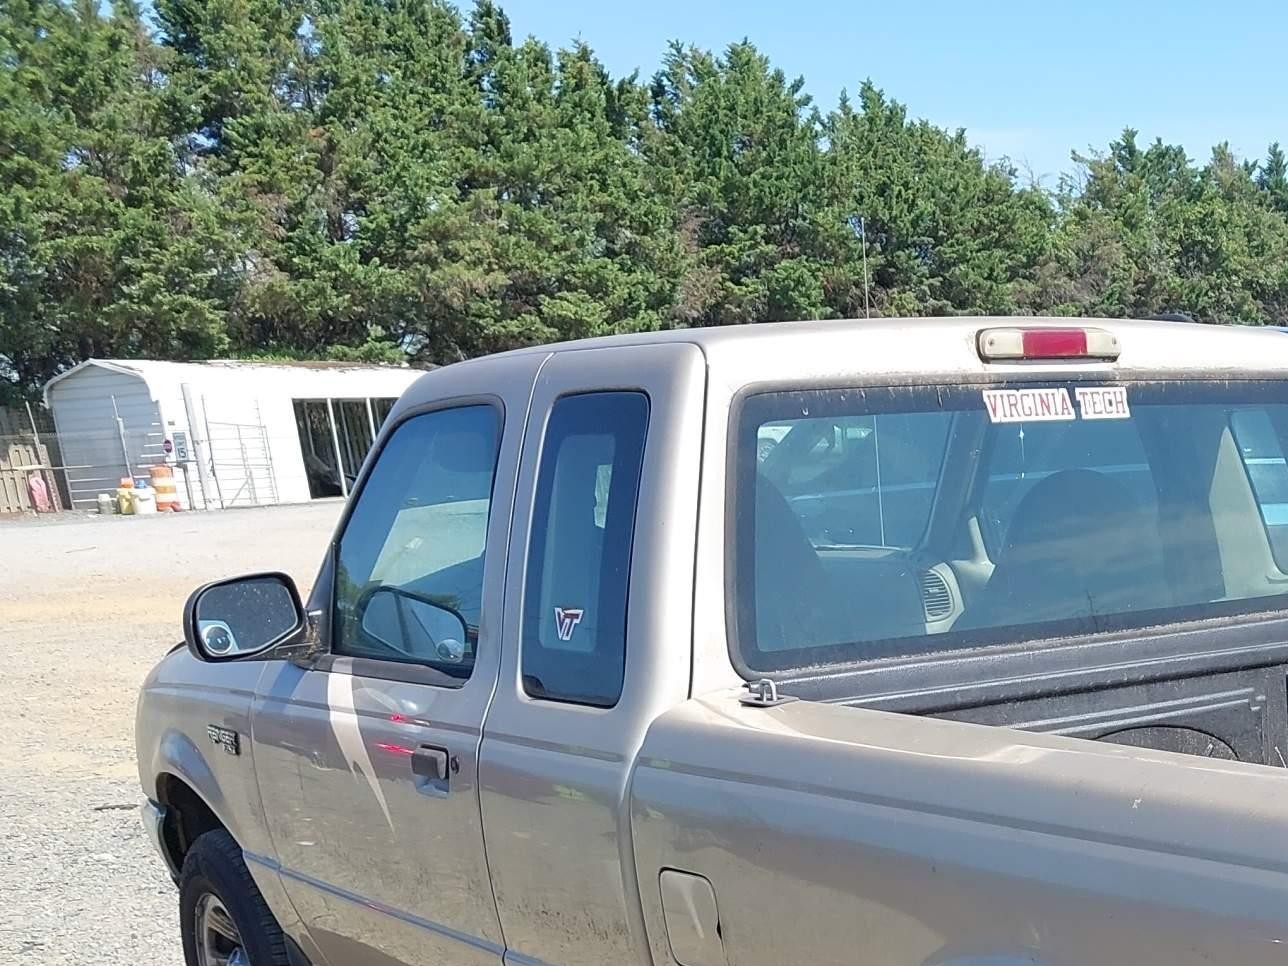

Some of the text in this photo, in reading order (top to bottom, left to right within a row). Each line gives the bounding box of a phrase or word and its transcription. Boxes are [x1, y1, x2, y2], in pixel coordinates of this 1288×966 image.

[986, 391, 1127, 419] VIRGINIA TECH
[554, 607, 585, 641] VT
